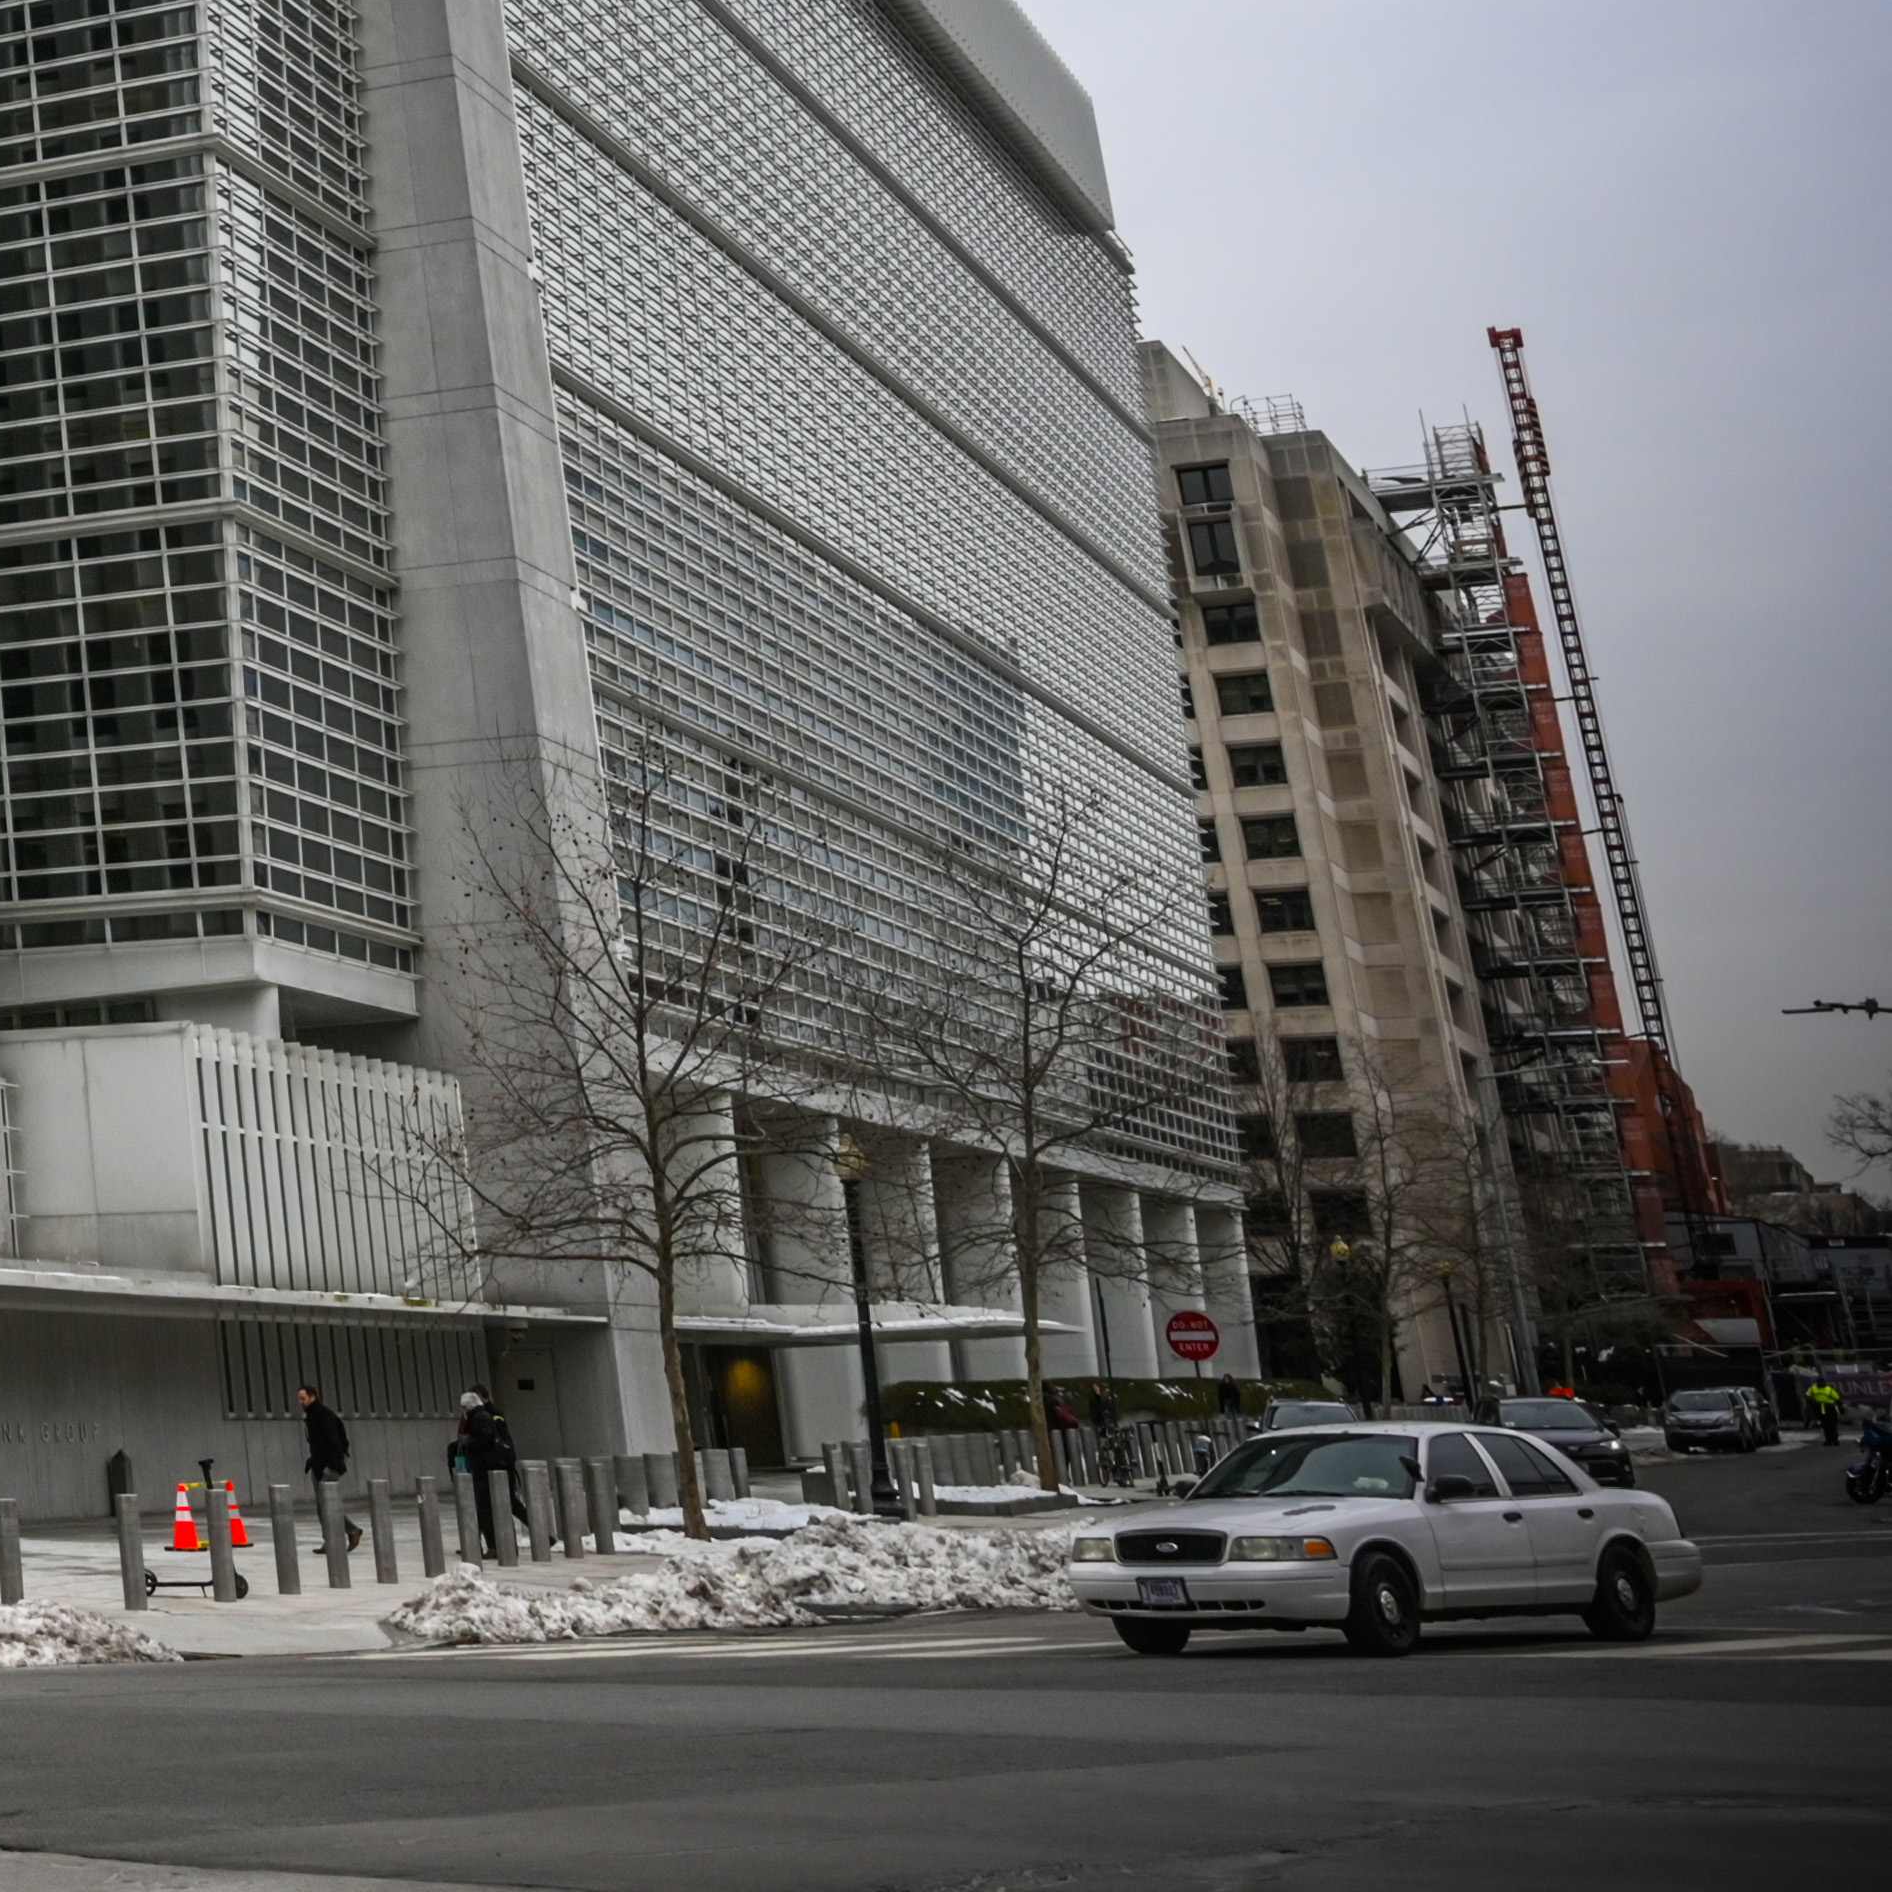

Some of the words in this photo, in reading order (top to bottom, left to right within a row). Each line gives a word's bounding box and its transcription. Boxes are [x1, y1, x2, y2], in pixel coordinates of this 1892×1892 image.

[1172, 1321, 1185, 1330] DO
[1190, 1320, 1208, 1330] NOT
[1178, 1342, 1209, 1352] ENTER
[39, 1422, 102, 1445] GROUP
